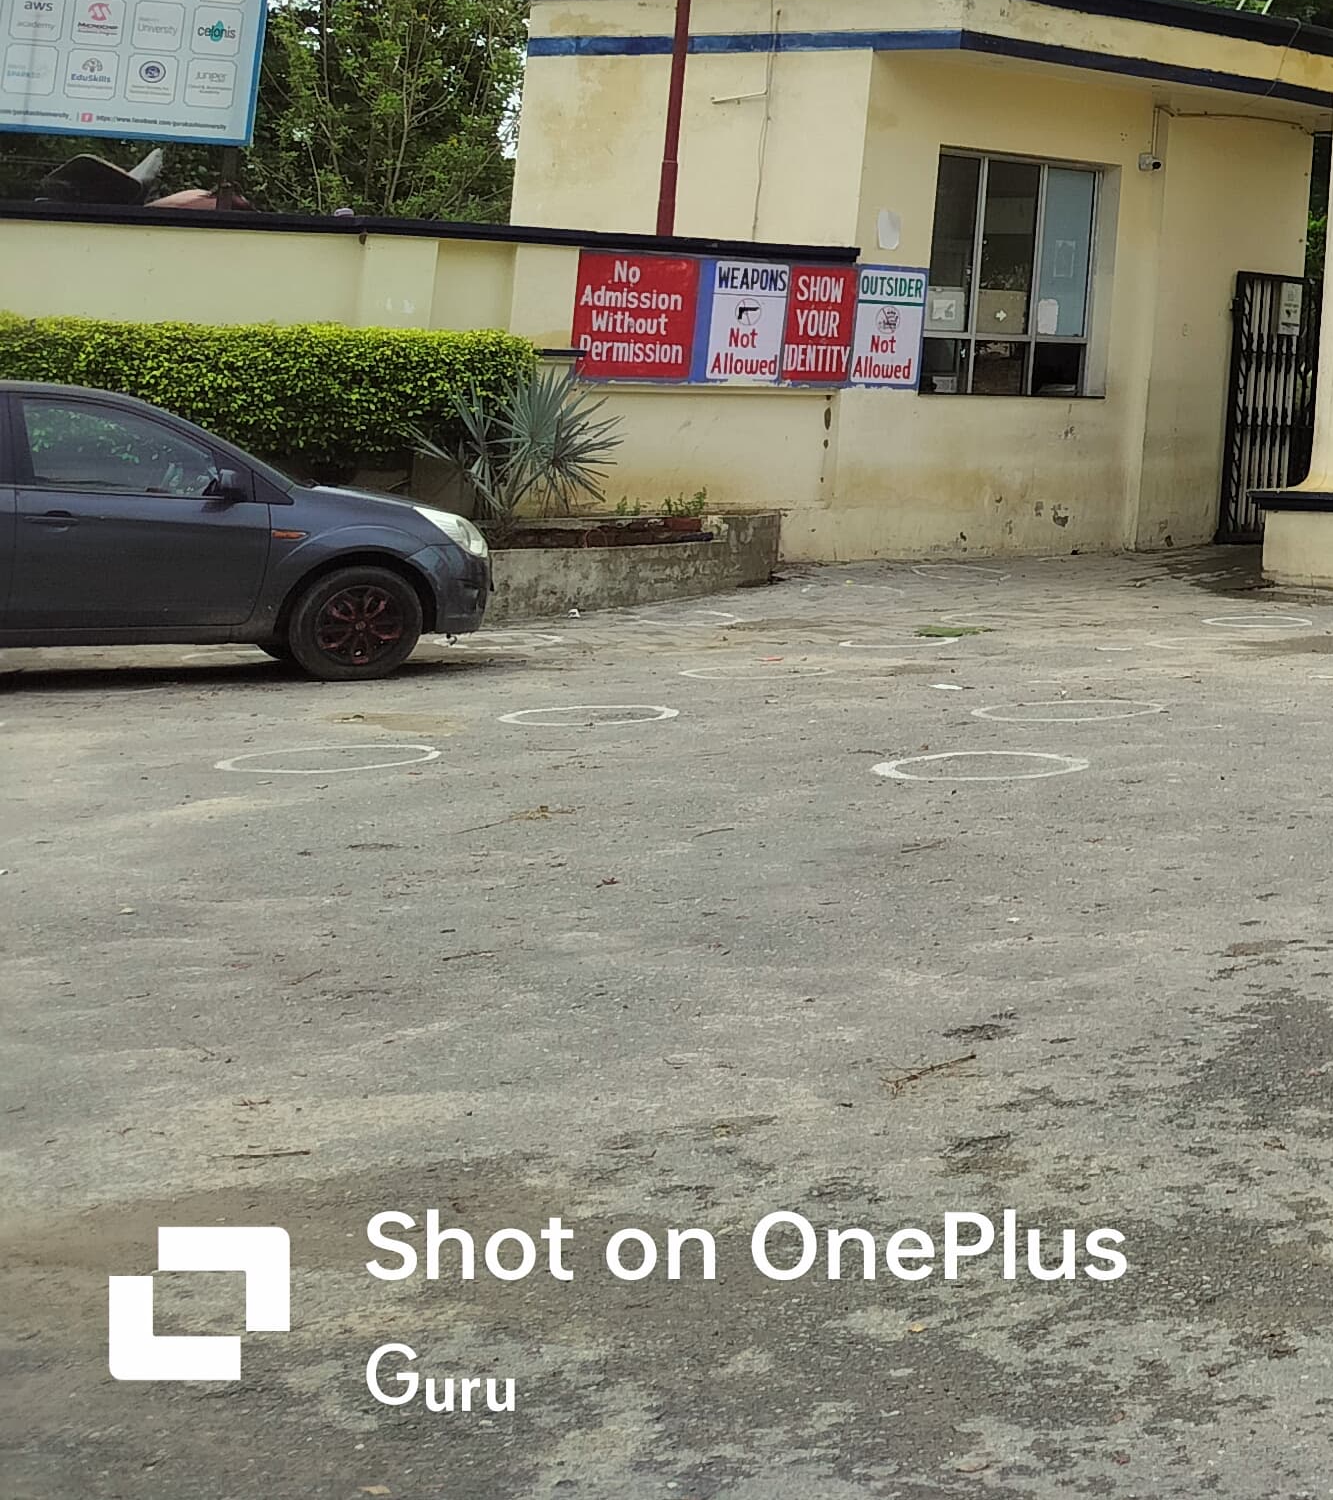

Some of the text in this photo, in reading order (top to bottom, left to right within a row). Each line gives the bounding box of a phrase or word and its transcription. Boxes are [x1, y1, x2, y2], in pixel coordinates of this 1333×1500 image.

[24, 0, 54, 12] aws
[17, 21, 56, 31] academy
[137, 23, 178, 36] University
[197, 24, 236, 39] celonis
[71, 73, 111, 83] EduSkills
[613, 260, 641, 284] No
[718, 266, 788, 292] WEAPONS
[580, 284, 682, 311] Admission
[796, 275, 845, 304] SHOW
[862, 275, 924, 299] OUTSIDER
[592, 310, 669, 336] Without
[796, 309, 840, 338] YOUR
[579, 335, 683, 365] Permission
[729, 328, 758, 348] Not
[870, 335, 896, 354] Not
[711, 352, 778, 376] Allowed
[783, 343, 851, 373] IDENTITY
[853, 356, 912, 380] Allowed
